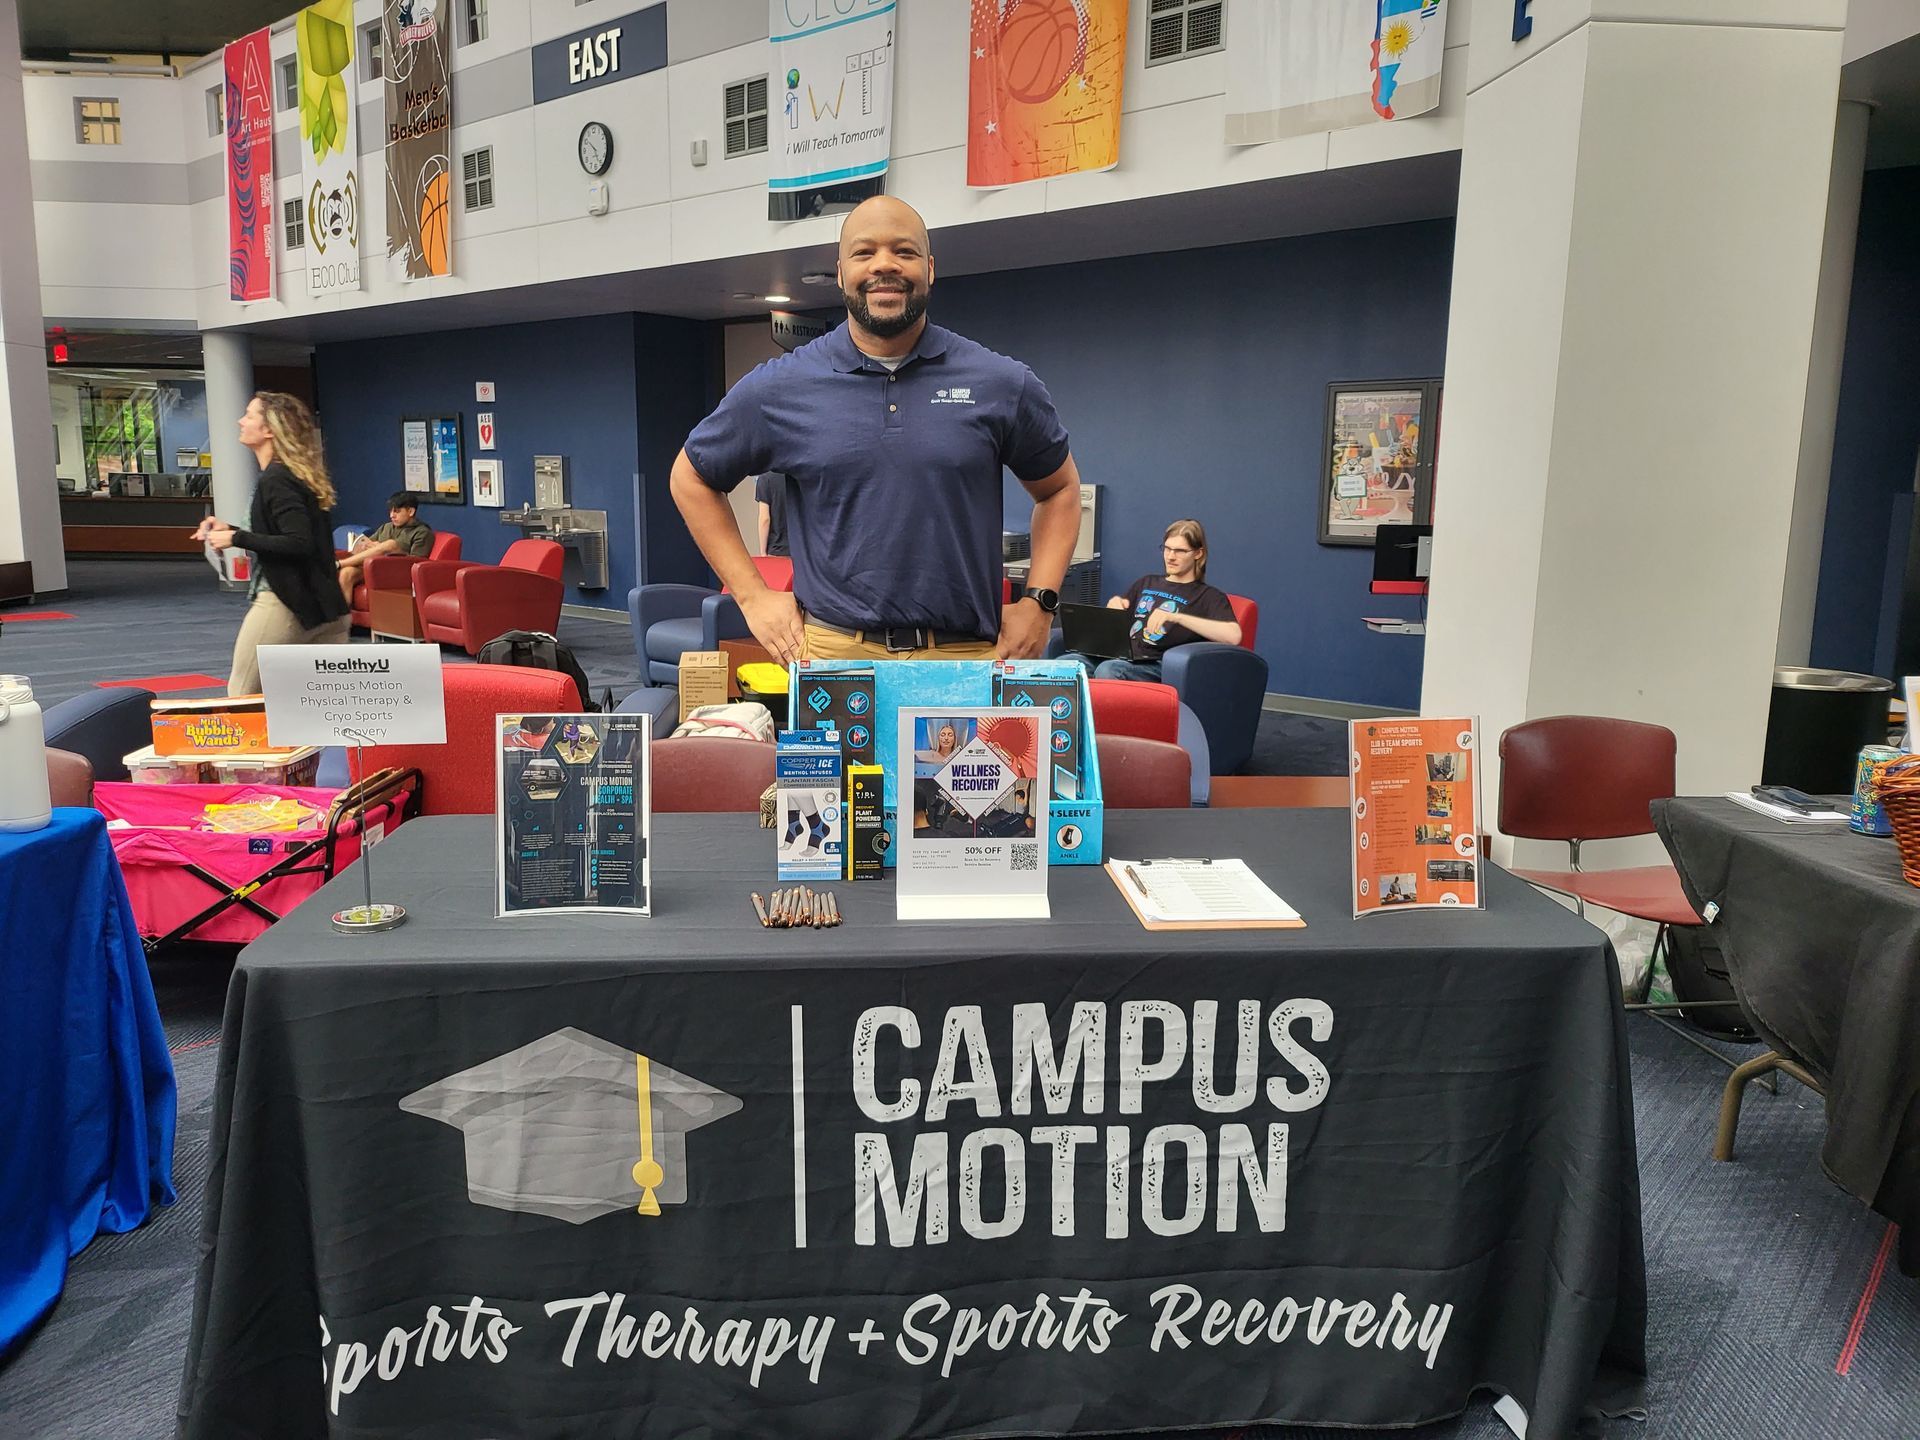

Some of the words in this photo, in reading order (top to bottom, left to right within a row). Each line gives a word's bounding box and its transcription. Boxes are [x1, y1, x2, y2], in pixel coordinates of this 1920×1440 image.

[568, 27, 621, 84] EAST
[405, 82, 439, 111] Men's
[241, 121, 251, 135] Art
[253, 116, 272, 130] Haus
[793, 139, 810, 154] Will
[813, 134, 838, 150] Teach
[841, 126, 886, 144] Tomorrow
[312, 264, 336, 289] ECO
[480, 415, 491, 423] AED
[315, 658, 390, 674] HealthyU
[306, 681, 355, 693] Campus
[359, 680, 403, 691] Motion
[300, 696, 348, 707] Physical
[350, 695, 400, 707] Therapy
[403, 695, 413, 705] &
[200, 717, 221, 726] Mini
[324, 711, 351, 723] Cryo
[355, 710, 393, 722] Sports
[186, 724, 233, 737] Bubble
[333, 727, 388, 737] Recovery
[194, 735, 239, 748] Wands
[1386, 739, 1400, 747] TEAM
[1401, 738, 1423, 746] SPORTS
[818, 759, 835, 767] ICE
[951, 765, 1000, 777] WELLNESS
[580, 777, 608, 786] CAMPUS
[609, 777, 632, 786] MOTION
[952, 778, 1000, 791] RECOVERY
[598, 785, 632, 795] CORPORATE
[621, 795, 632, 804] SPA
[1056, 809, 1091, 818] SLEEVE
[965, 847, 983, 855] 50%
[984, 846, 1003, 855] OFF
[852, 998, 1334, 1122] CAMPUS
[854, 1123, 1290, 1248] MOTION
[544, 1290, 836, 1389] Therapy
[848, 1319, 885, 1356] +
[895, 1287, 1128, 1378] Sports
[1149, 1283, 1454, 1370] Recovery
